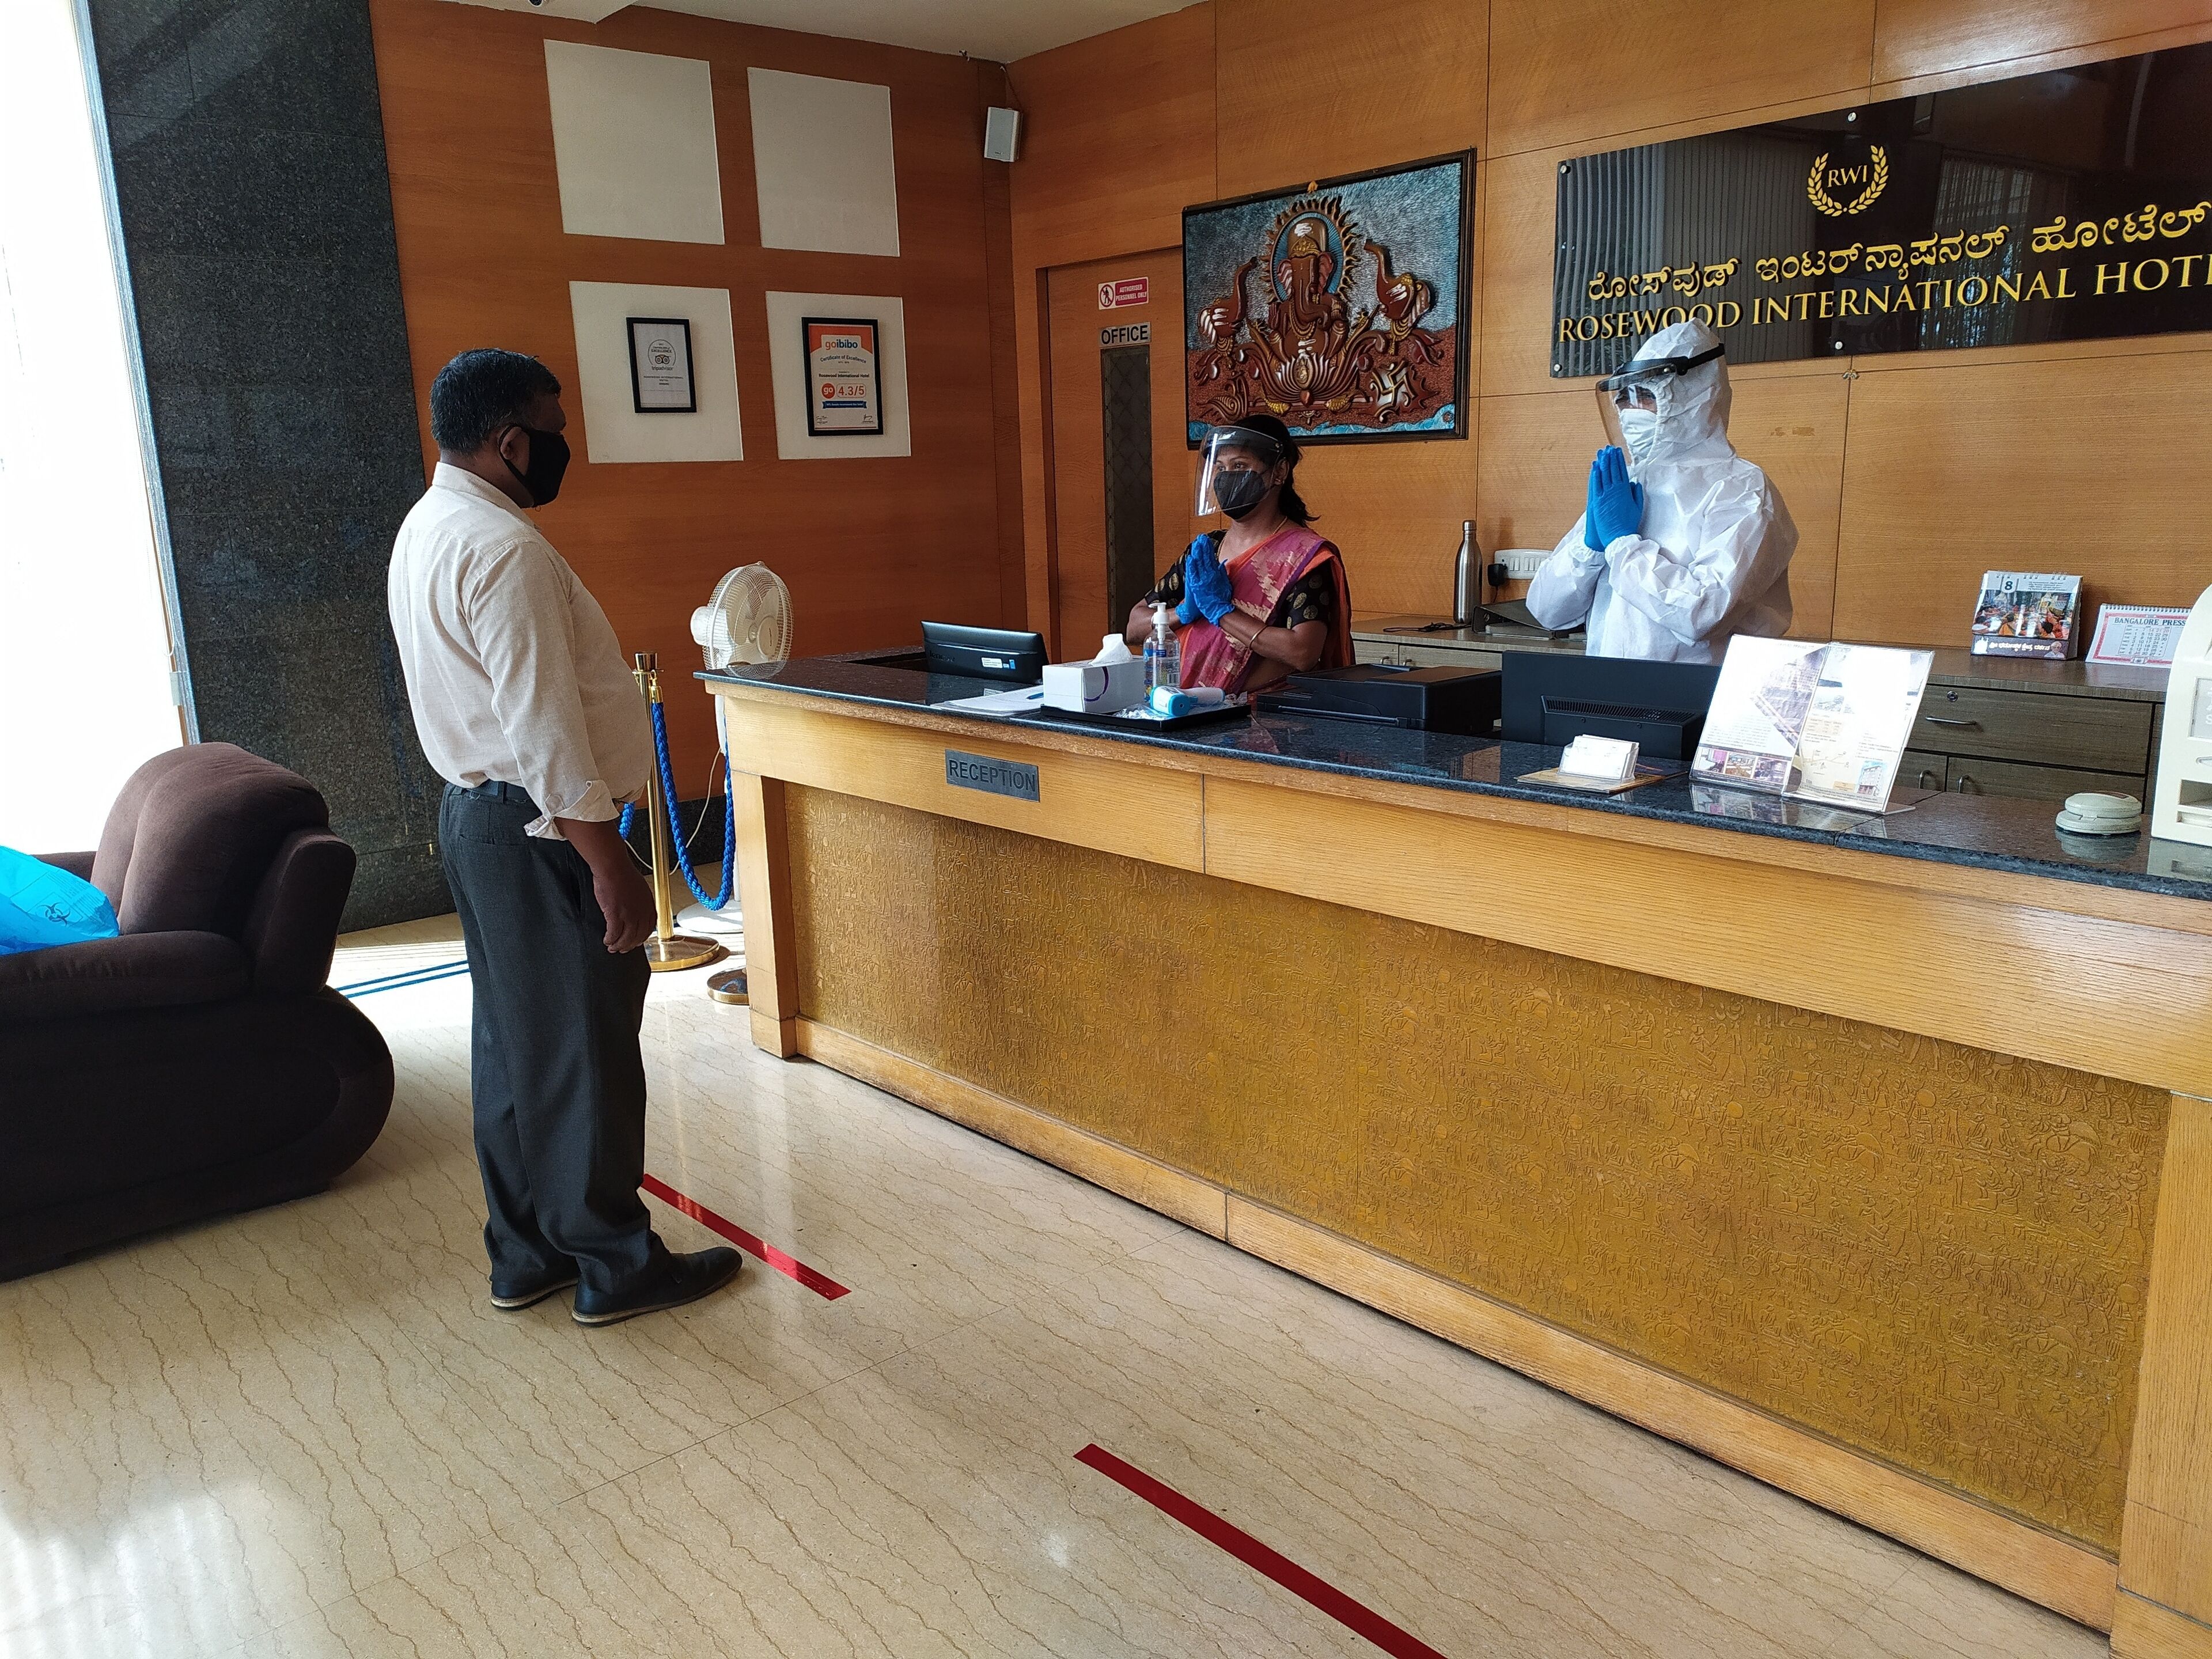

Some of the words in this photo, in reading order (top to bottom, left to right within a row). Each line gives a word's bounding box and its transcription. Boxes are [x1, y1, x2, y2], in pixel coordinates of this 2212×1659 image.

[1827, 165, 1868, 188] RWI
[1116, 293, 1137, 301] PERSONNEL
[1559, 301, 1741, 343] ROSEWOOD
[1752, 268, 2077, 325] INTERNATIONAL
[1101, 325, 1148, 344] OFFICE
[825, 339, 858, 350] goibibo
[846, 355, 866, 363] Excellence
[839, 385, 864, 396] 4.3/5
[2004, 581, 2013, 590] 8
[2114, 617, 2160, 626] BANGALORE
[949, 759, 1035, 792] RECEPTION
